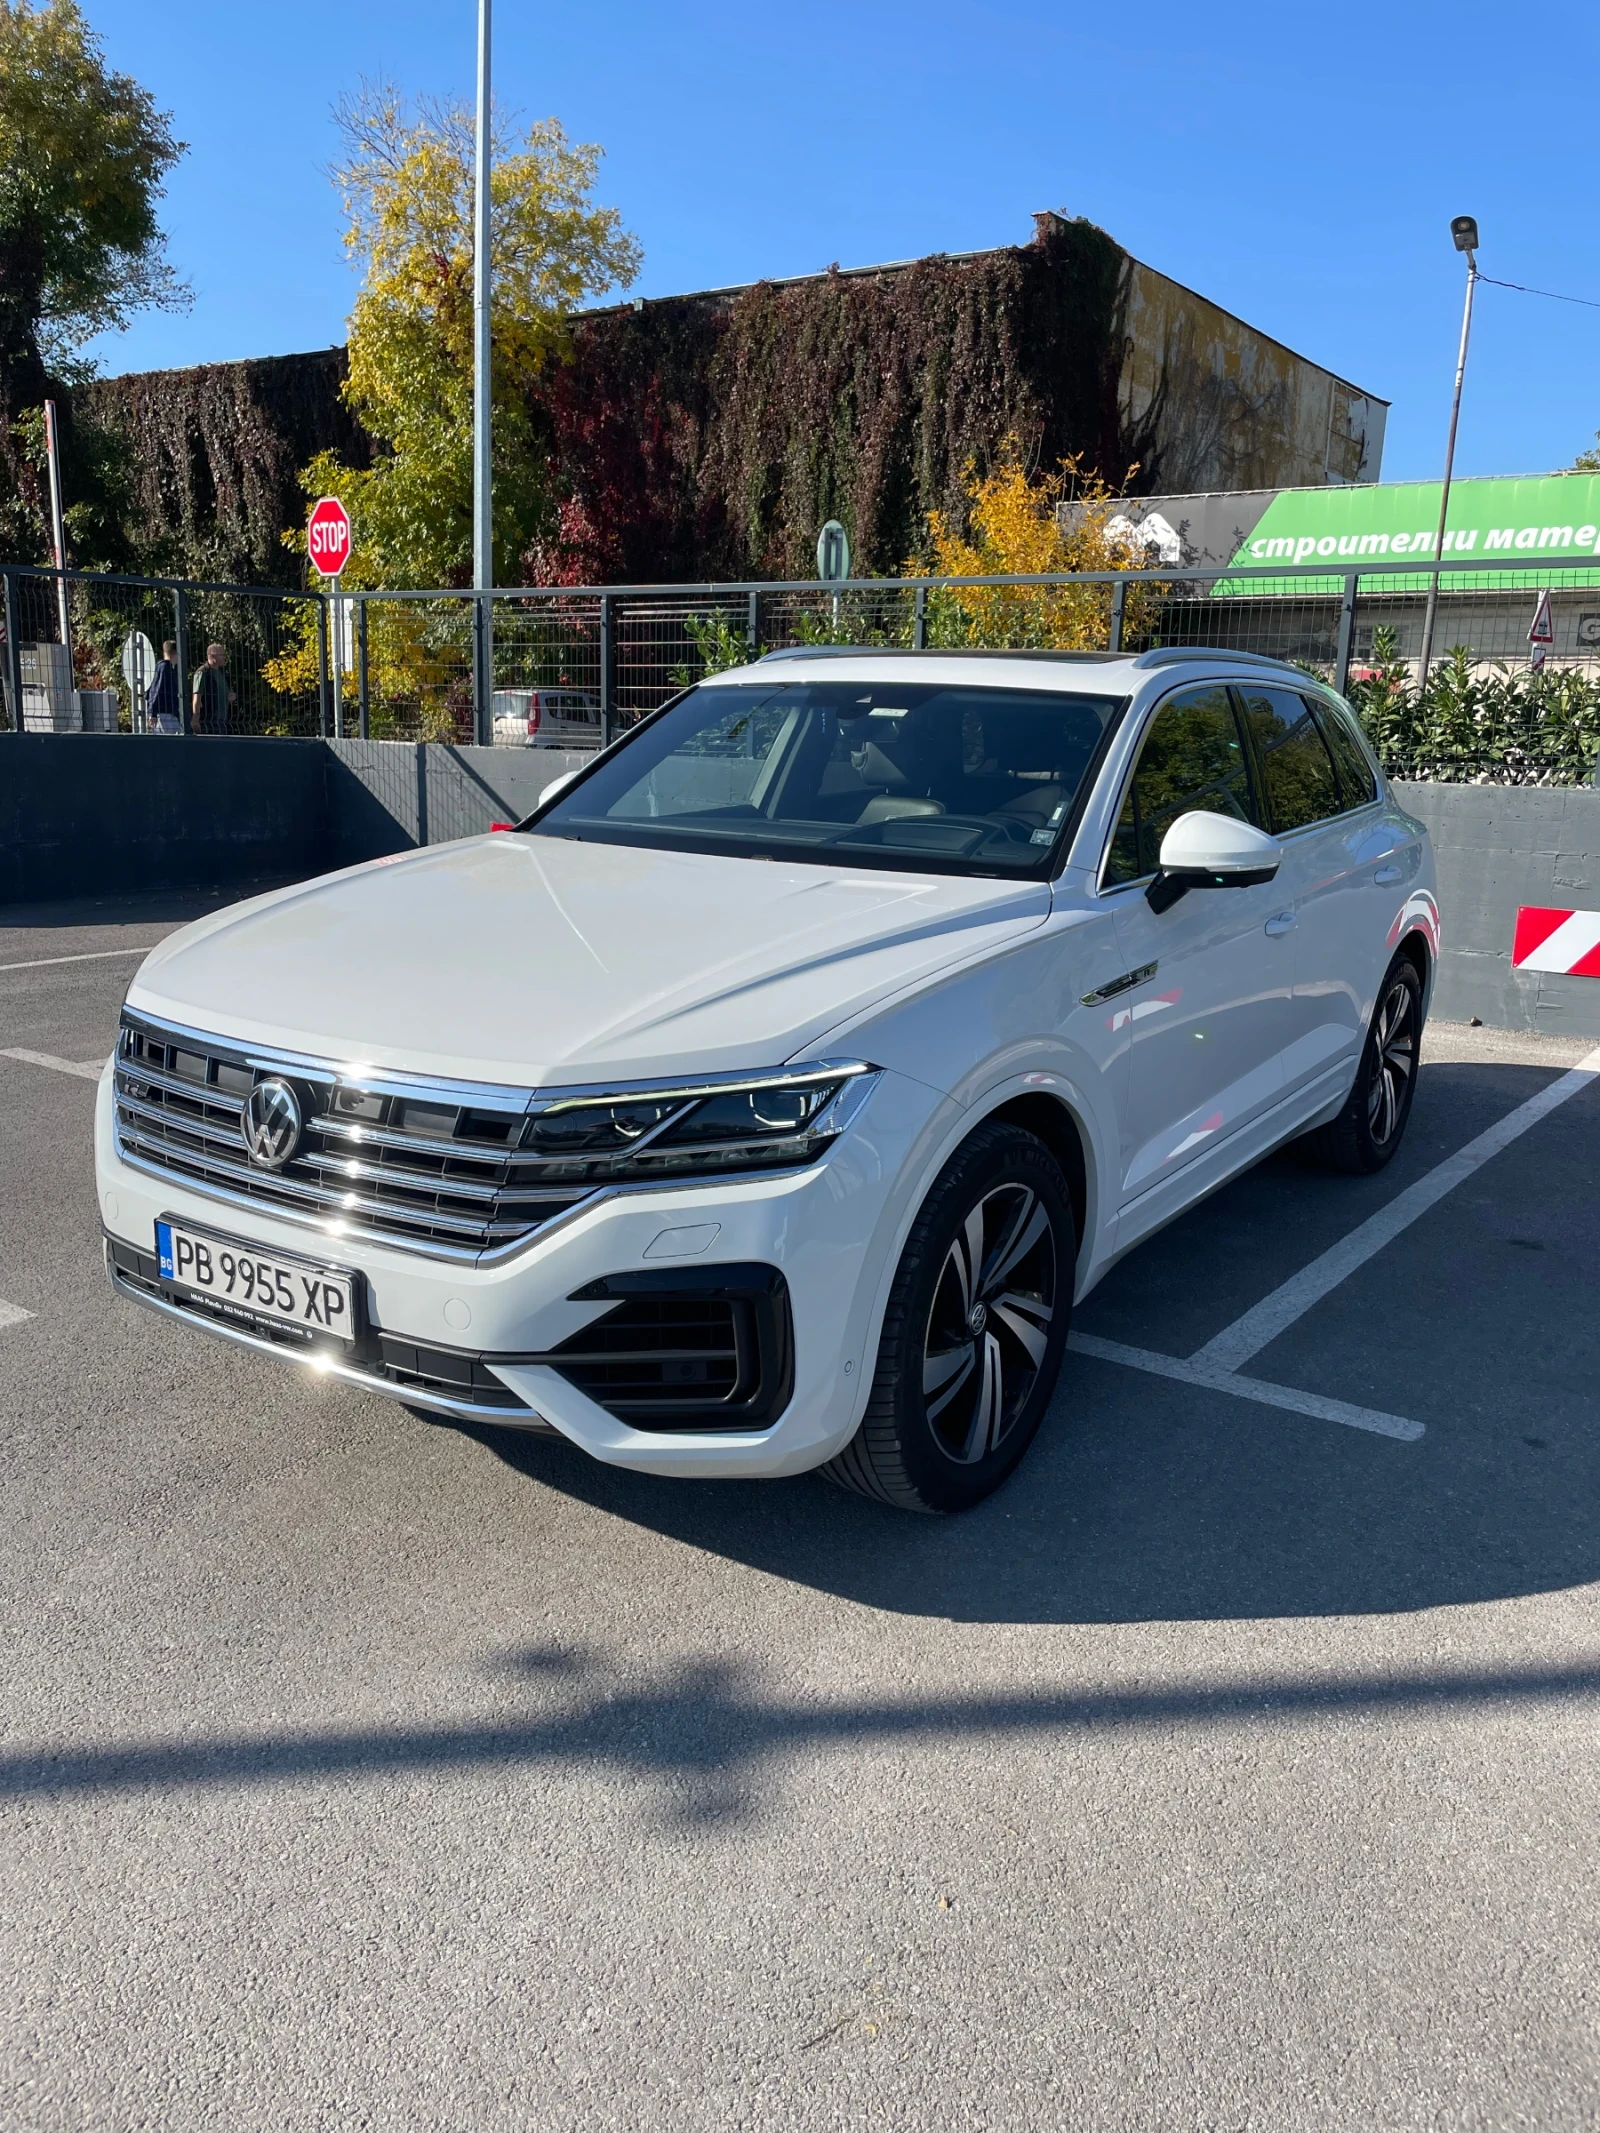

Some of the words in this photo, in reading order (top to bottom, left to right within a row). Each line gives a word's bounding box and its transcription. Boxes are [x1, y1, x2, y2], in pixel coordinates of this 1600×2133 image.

[312, 521, 347, 553] STOP
[1251, 529, 1478, 564] строителни
[160, 1256, 173, 1271] BG
[175, 1235, 214, 1286] PB
[219, 1251, 296, 1313] 9955
[301, 1275, 345, 1327] XP
[190, 1292, 204, 1304] HAAS
